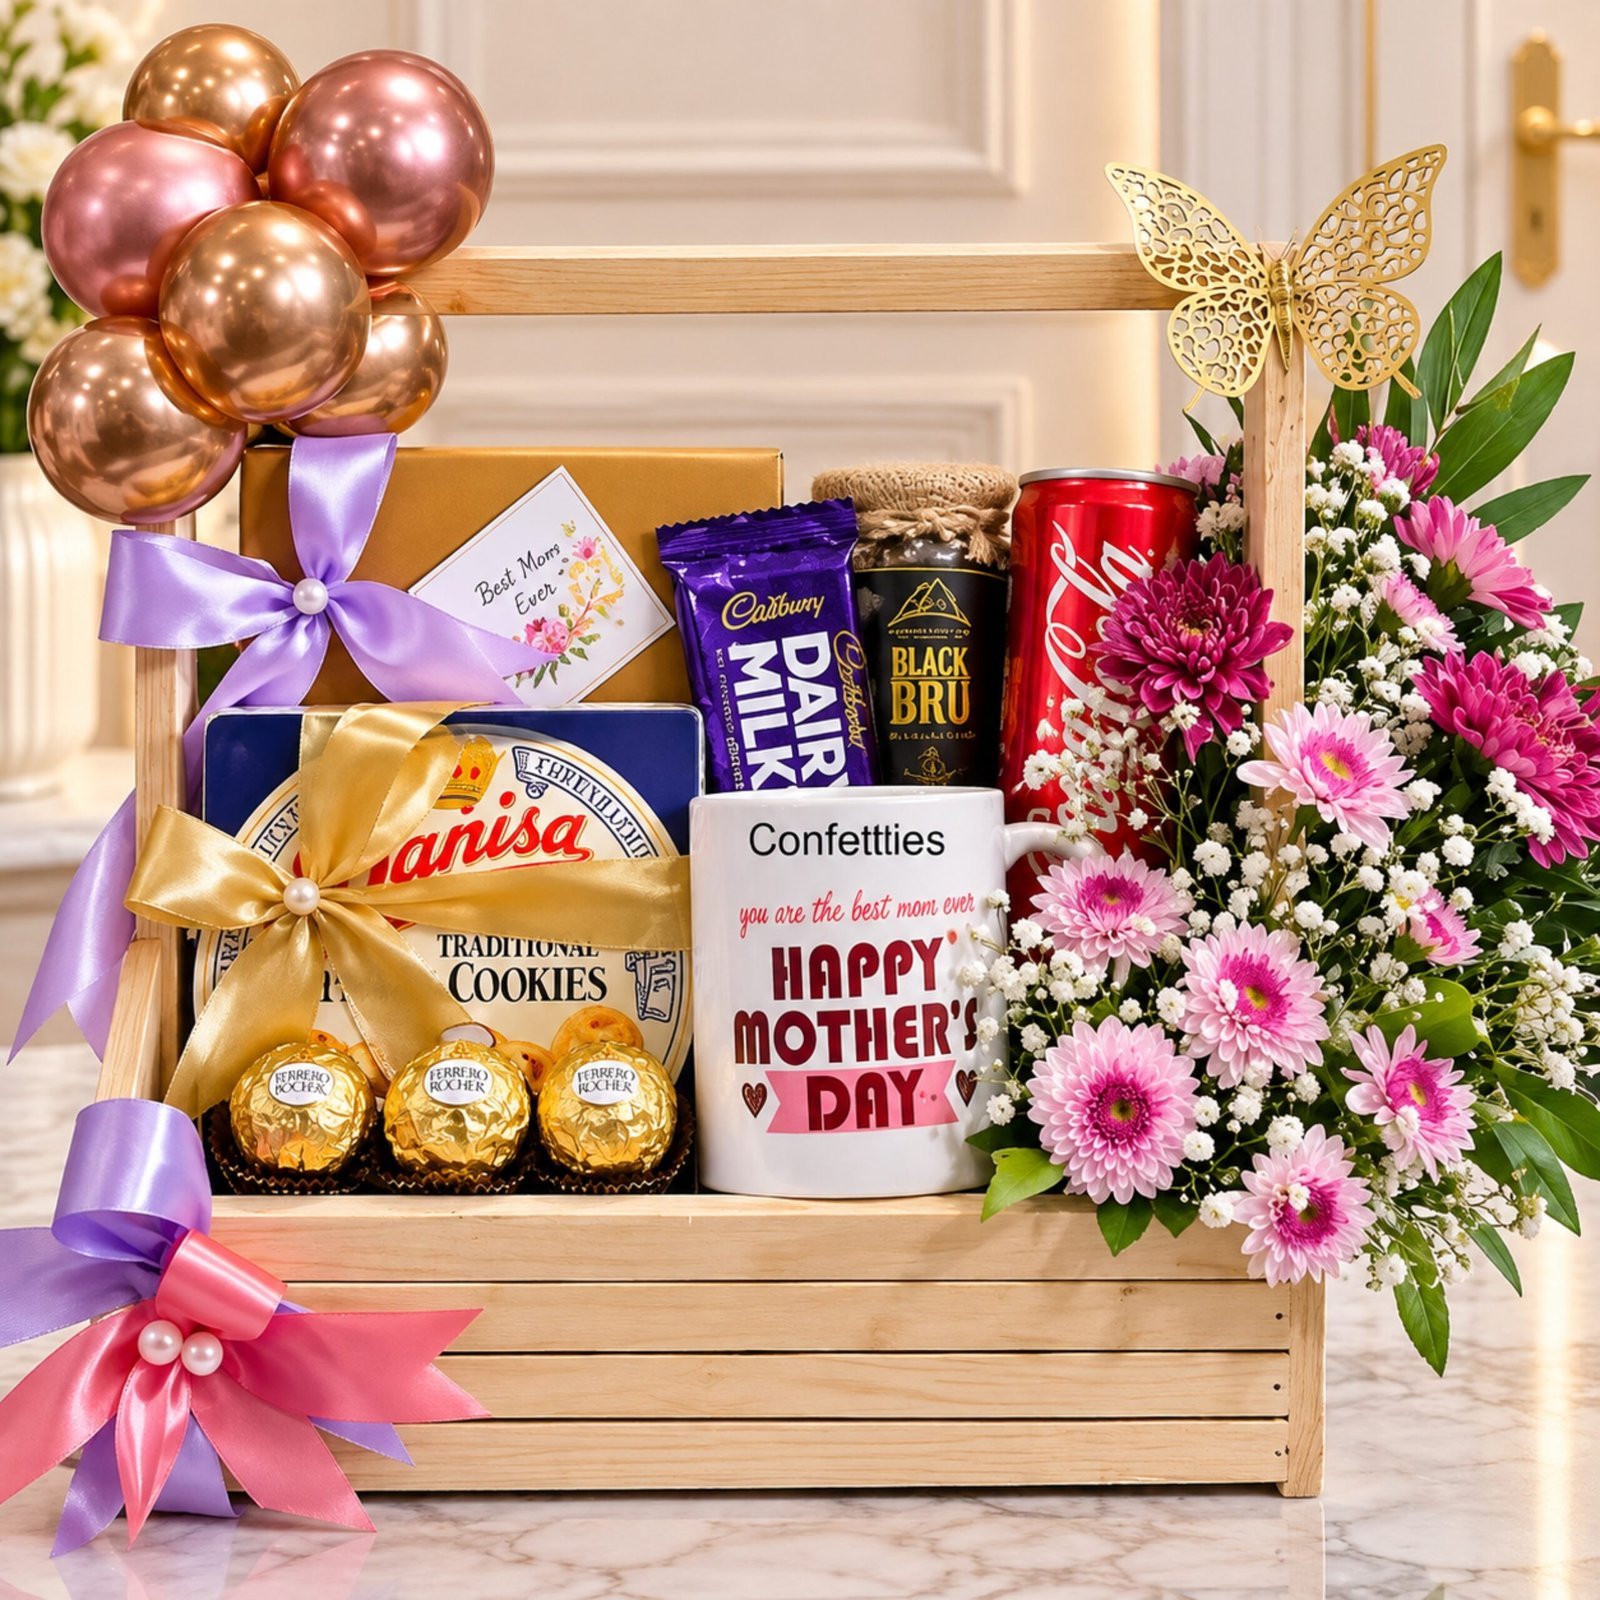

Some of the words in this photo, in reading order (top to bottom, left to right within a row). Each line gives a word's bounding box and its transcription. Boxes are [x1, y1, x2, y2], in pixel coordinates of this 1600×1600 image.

[474, 567, 517, 606] Best
[514, 583, 557, 615] Ever
[721, 591, 825, 631] Cadbury
[891, 646, 970, 676] BLACK
[728, 640, 797, 790] MILK
[782, 631, 850, 787] DAIR
[890, 681, 970, 725] BRU
[345, 791, 594, 886] anisa
[749, 822, 945, 856] Confettties
[739, 905, 769, 939] you
[774, 904, 806, 924] are
[812, 890, 844, 924] the
[851, 889, 892, 922] best
[896, 898, 938, 918] mom
[943, 893, 975, 914] ever
[449, 961, 607, 1003] COOKIES
[771, 937, 943, 1000] HAPPY
[734, 997, 978, 1065] MOTHER'S
[806, 1068, 924, 1132] DAY
